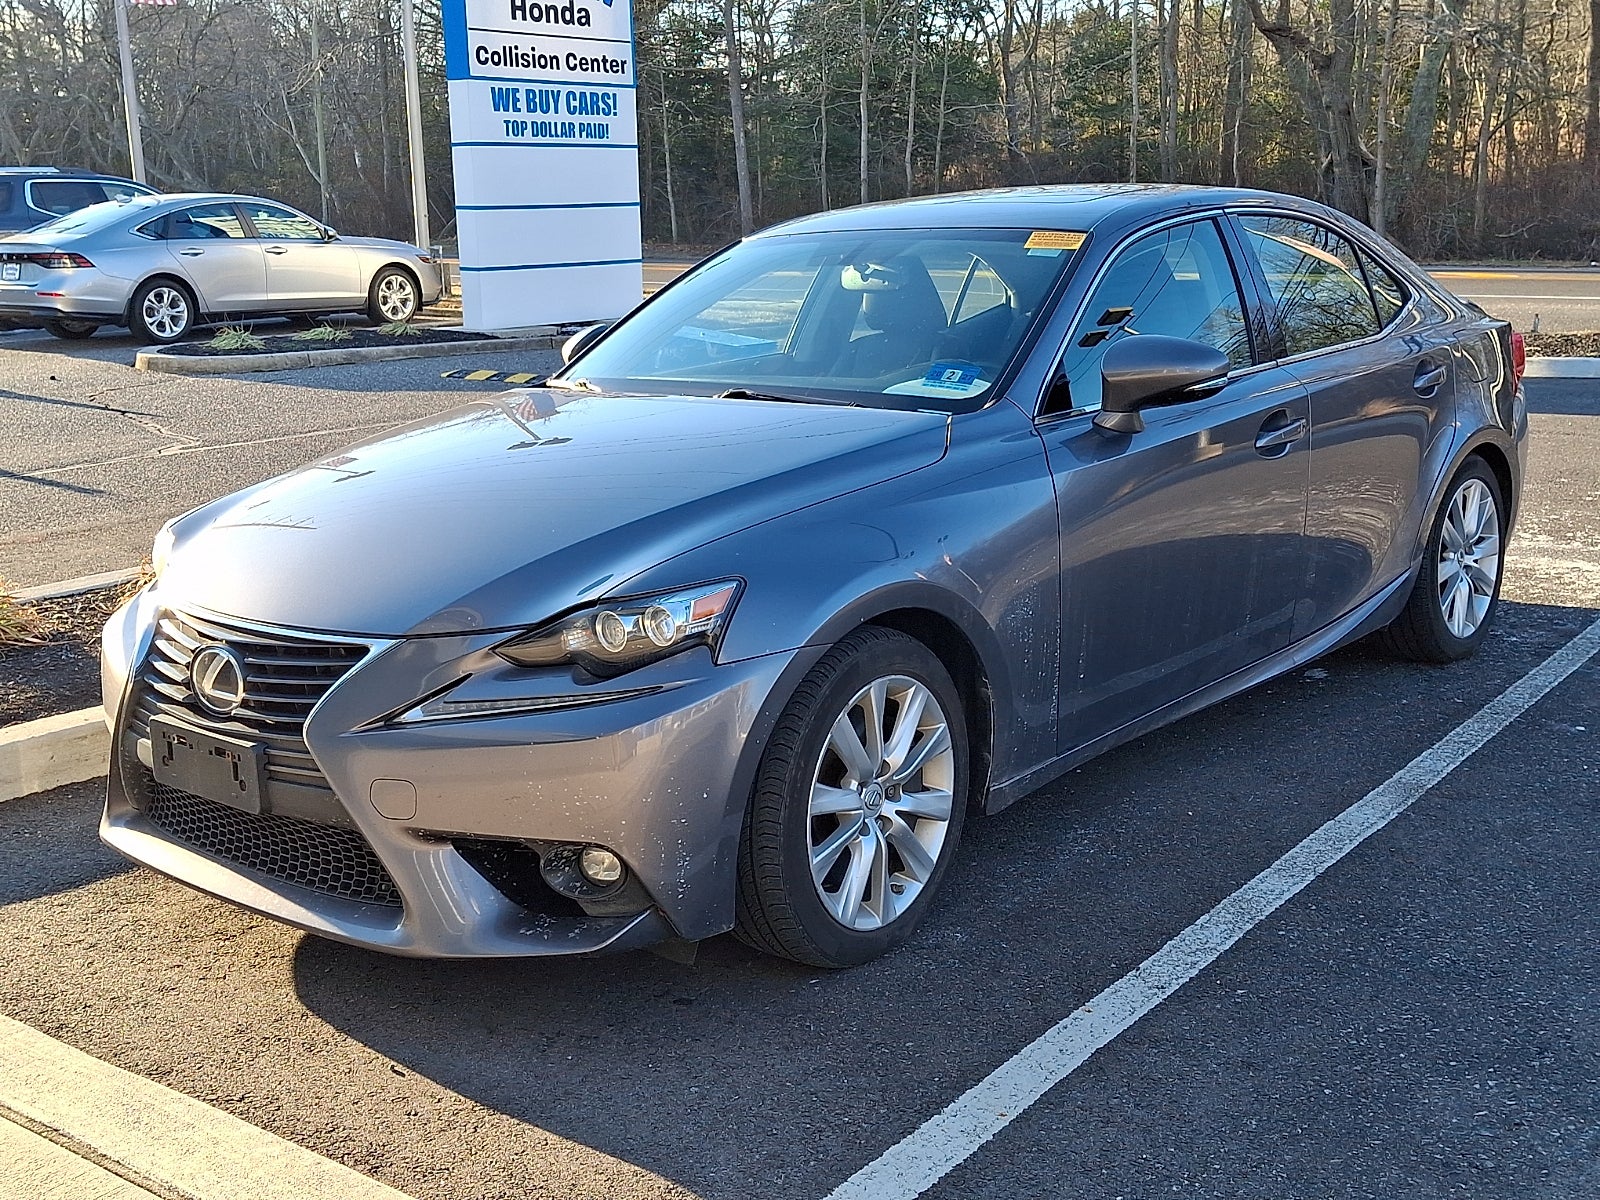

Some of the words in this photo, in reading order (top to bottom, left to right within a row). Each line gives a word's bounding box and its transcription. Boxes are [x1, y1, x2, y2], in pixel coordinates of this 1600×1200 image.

[510, 0, 591, 27] Honda
[475, 45, 560, 70] Collision
[565, 52, 627, 74] Center
[490, 86, 522, 112] WE
[525, 89, 561, 115] BUY
[566, 90, 618, 116] CARS!
[503, 119, 528, 137] TOP
[531, 121, 576, 139] DOLLAR
[578, 122, 610, 139] PAID!
